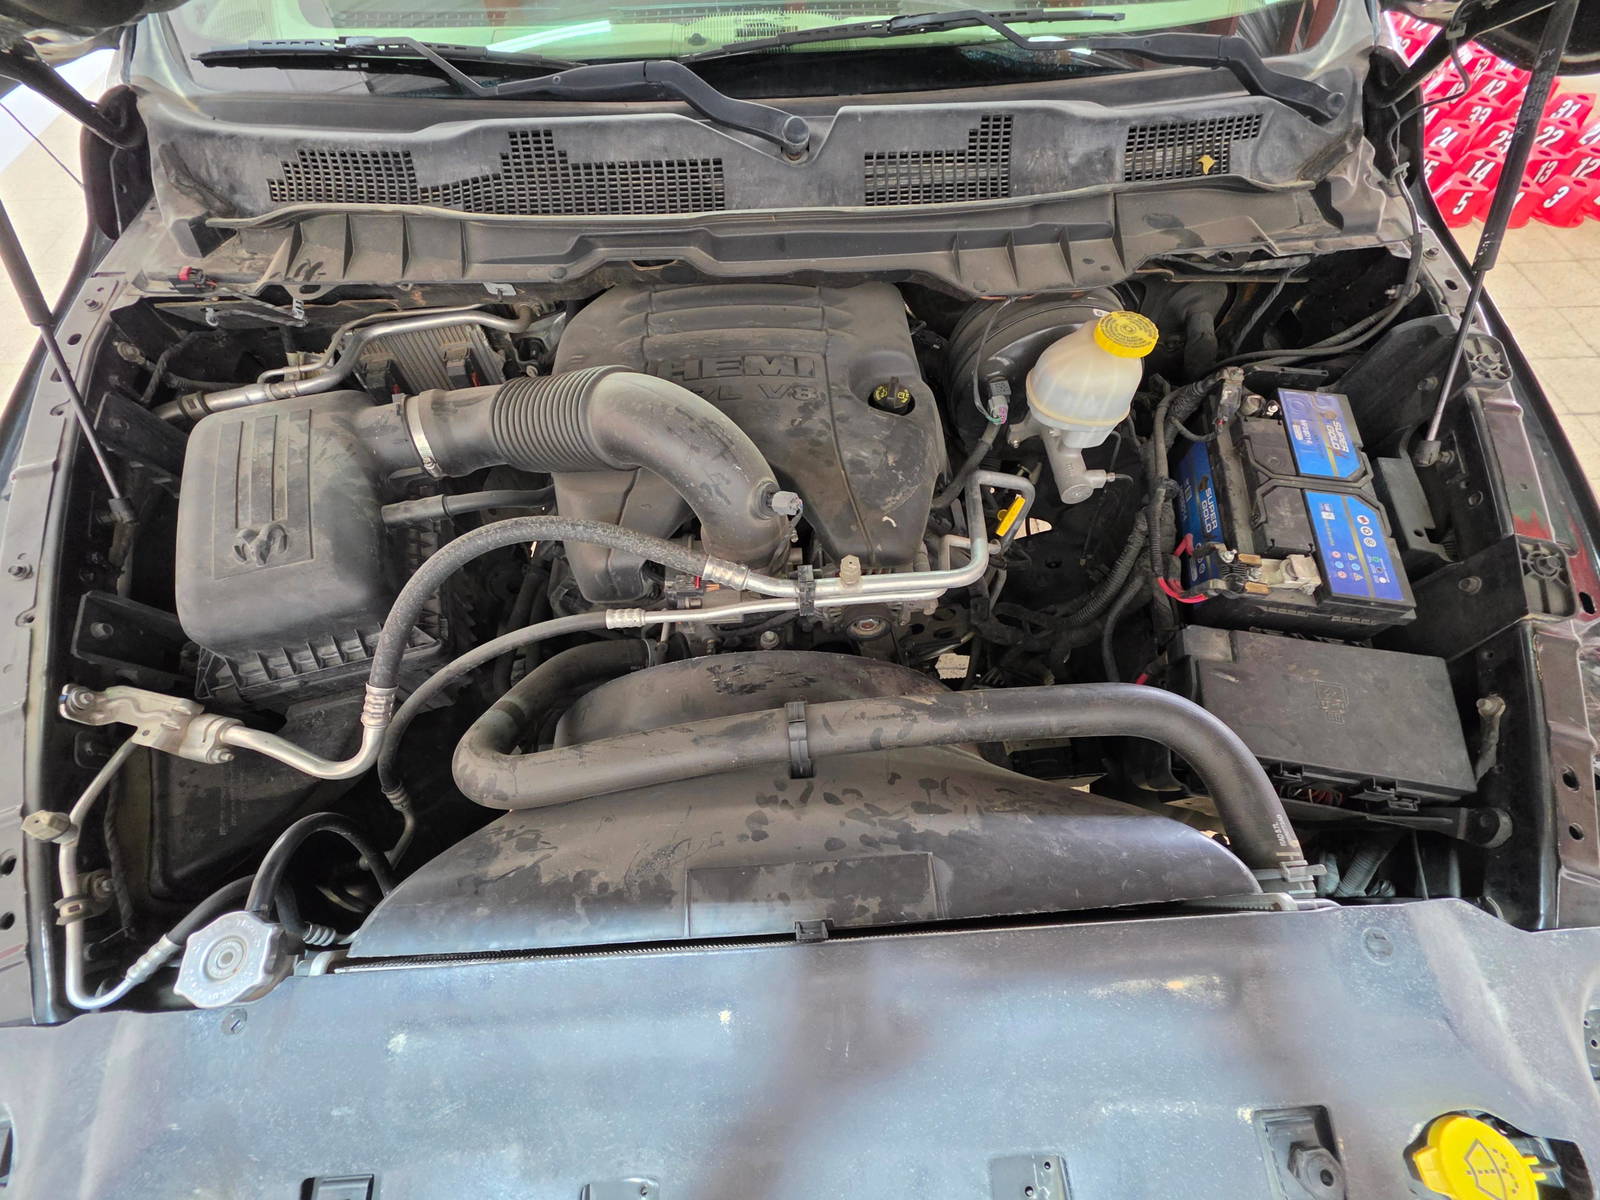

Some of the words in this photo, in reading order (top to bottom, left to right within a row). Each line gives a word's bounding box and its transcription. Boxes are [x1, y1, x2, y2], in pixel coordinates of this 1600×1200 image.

[1481, 79, 1507, 97] 42
[1549, 99, 1582, 118] 31
[1429, 126, 1459, 148] 24
[1533, 125, 1566, 148] 22
[1466, 159, 1497, 184] 14
[1532, 160, 1559, 184] 13
[1570, 156, 1600, 179] 12
[1451, 191, 1475, 215] 5
[1543, 185, 1571, 209] 3
[652, 354, 816, 381] HEMI
[1326, 424, 1340, 450] GOLD
[1332, 420, 1349, 453] SUPER
[1201, 499, 1212, 534] GOLD
[1205, 487, 1218, 530] SUPER
